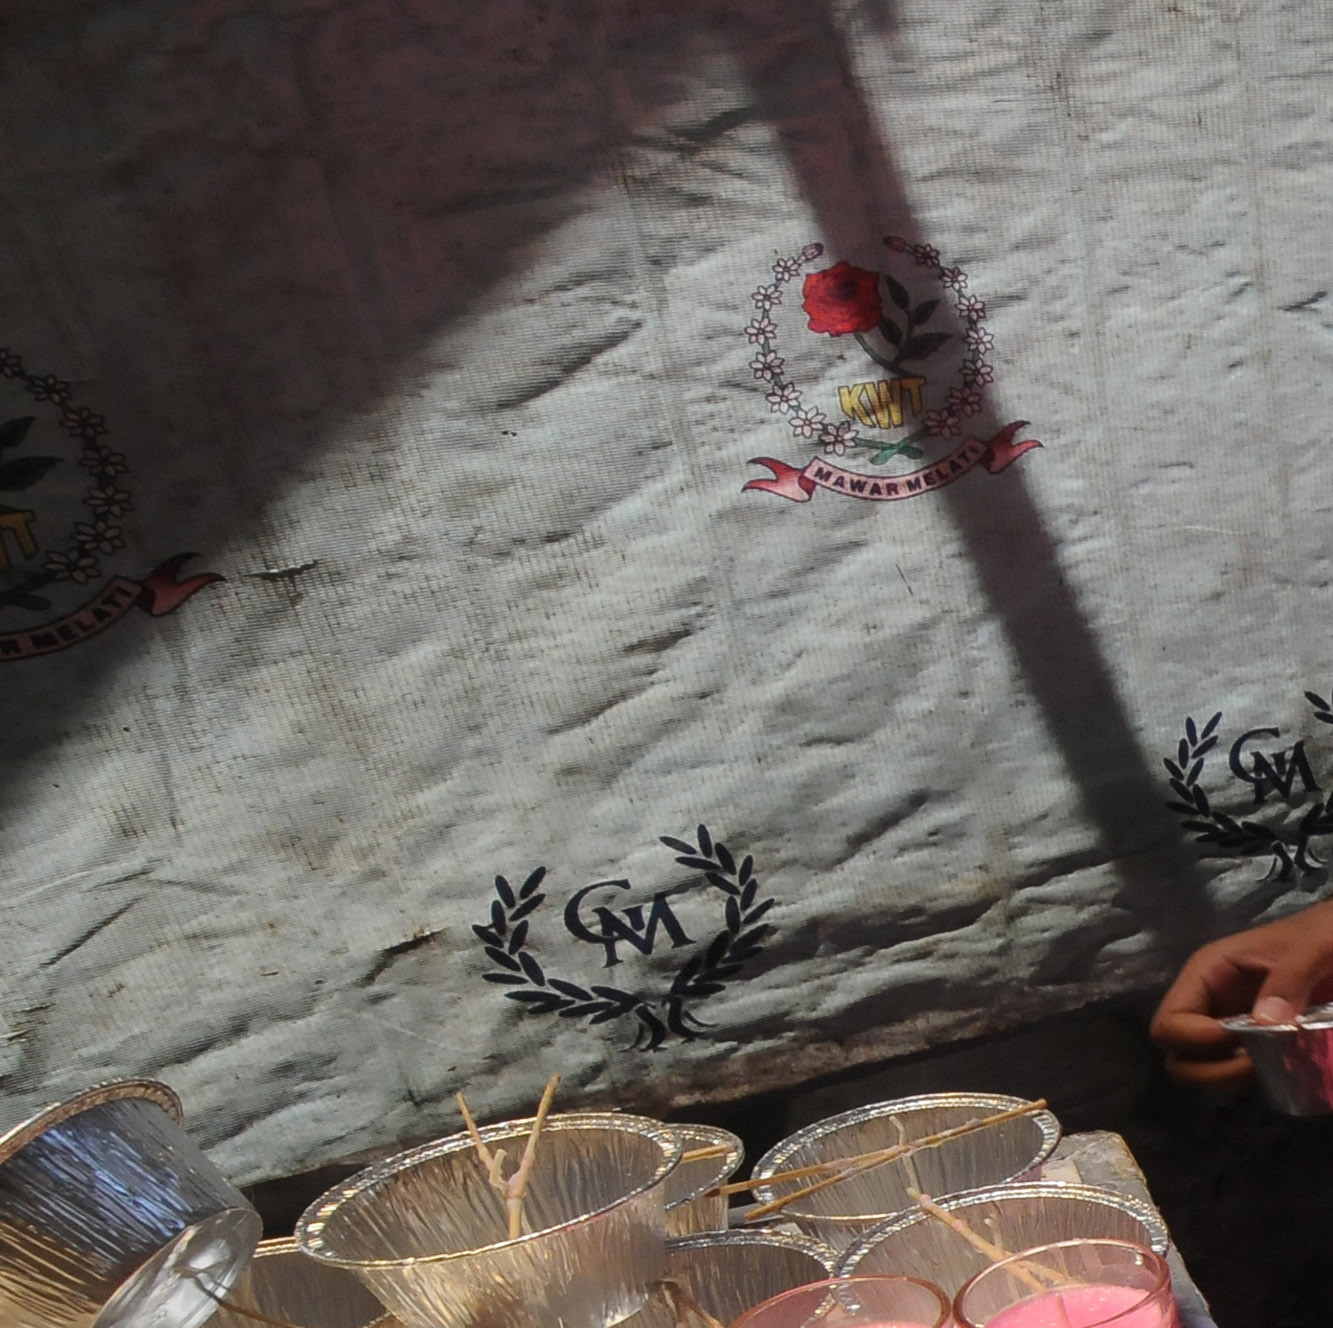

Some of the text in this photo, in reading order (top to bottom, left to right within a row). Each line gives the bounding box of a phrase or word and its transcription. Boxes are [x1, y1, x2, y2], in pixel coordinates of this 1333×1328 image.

[838, 376, 926, 430] KWT
[814, 444, 980, 496] MAWAR MELATI
